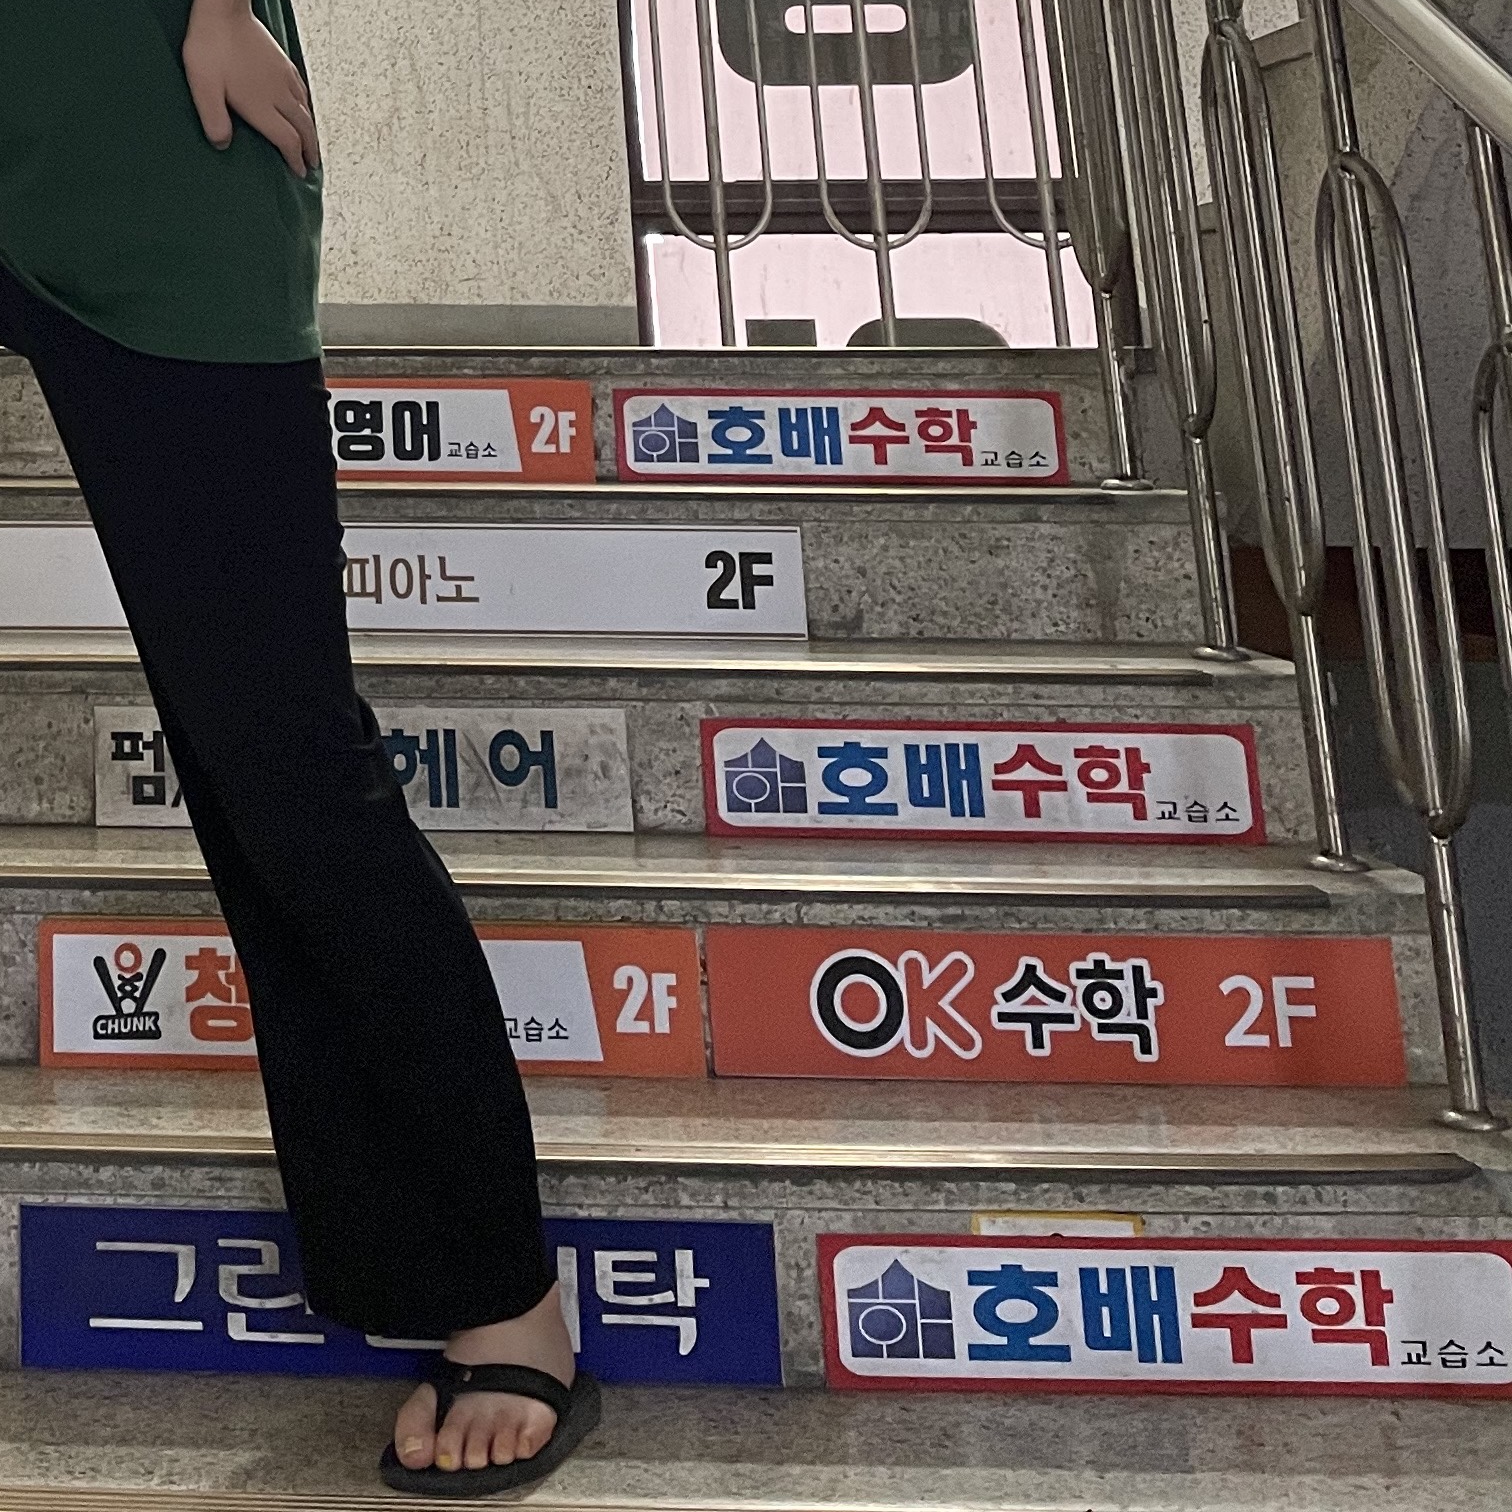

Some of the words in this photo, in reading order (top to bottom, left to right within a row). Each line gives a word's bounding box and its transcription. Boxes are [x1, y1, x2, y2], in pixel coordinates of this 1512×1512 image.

[445, 440, 498, 461] 교습소
[528, 404, 577, 455] 2F
[706, 405, 978, 468] 호배수학
[980, 448, 1050, 470] 교습소
[703, 550, 774, 611] 2F
[816, 740, 1152, 822] 호배수학
[1154, 799, 1241, 823] 교습소
[96, 1015, 158, 1037] CHUNK
[613, 964, 678, 1036] 2F
[810, 947, 983, 1061] OK
[991, 953, 1164, 1064] 수학
[1220, 974, 1317, 1050] 2F
[966, 1263, 1394, 1367] 호배수학
[1400, 1337, 1510, 1370] 교습소
